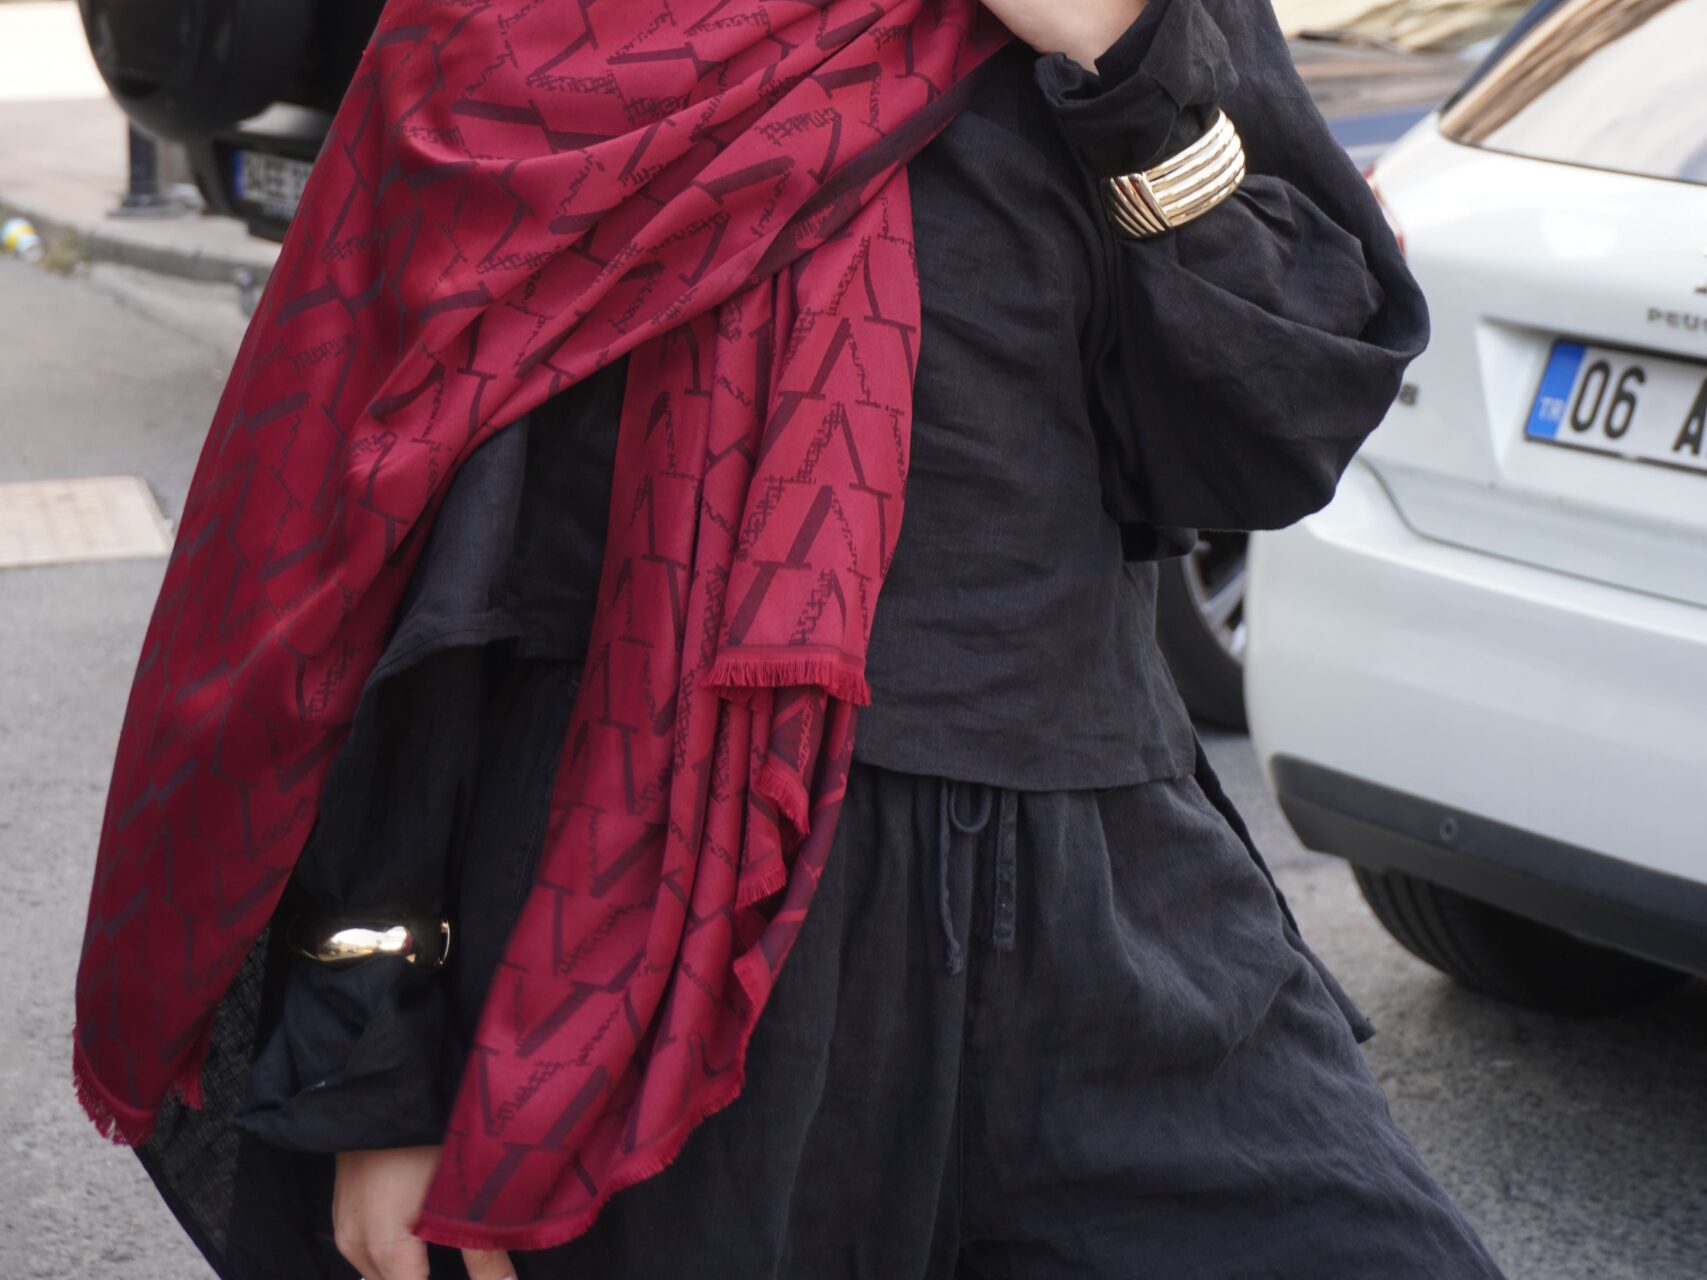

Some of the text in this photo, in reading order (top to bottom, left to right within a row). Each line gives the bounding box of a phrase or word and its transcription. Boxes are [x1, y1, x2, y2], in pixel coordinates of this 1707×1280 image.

[1647, 307, 1707, 334] PEU
[1539, 396, 1565, 419] TR
[1570, 359, 1646, 439] 06
